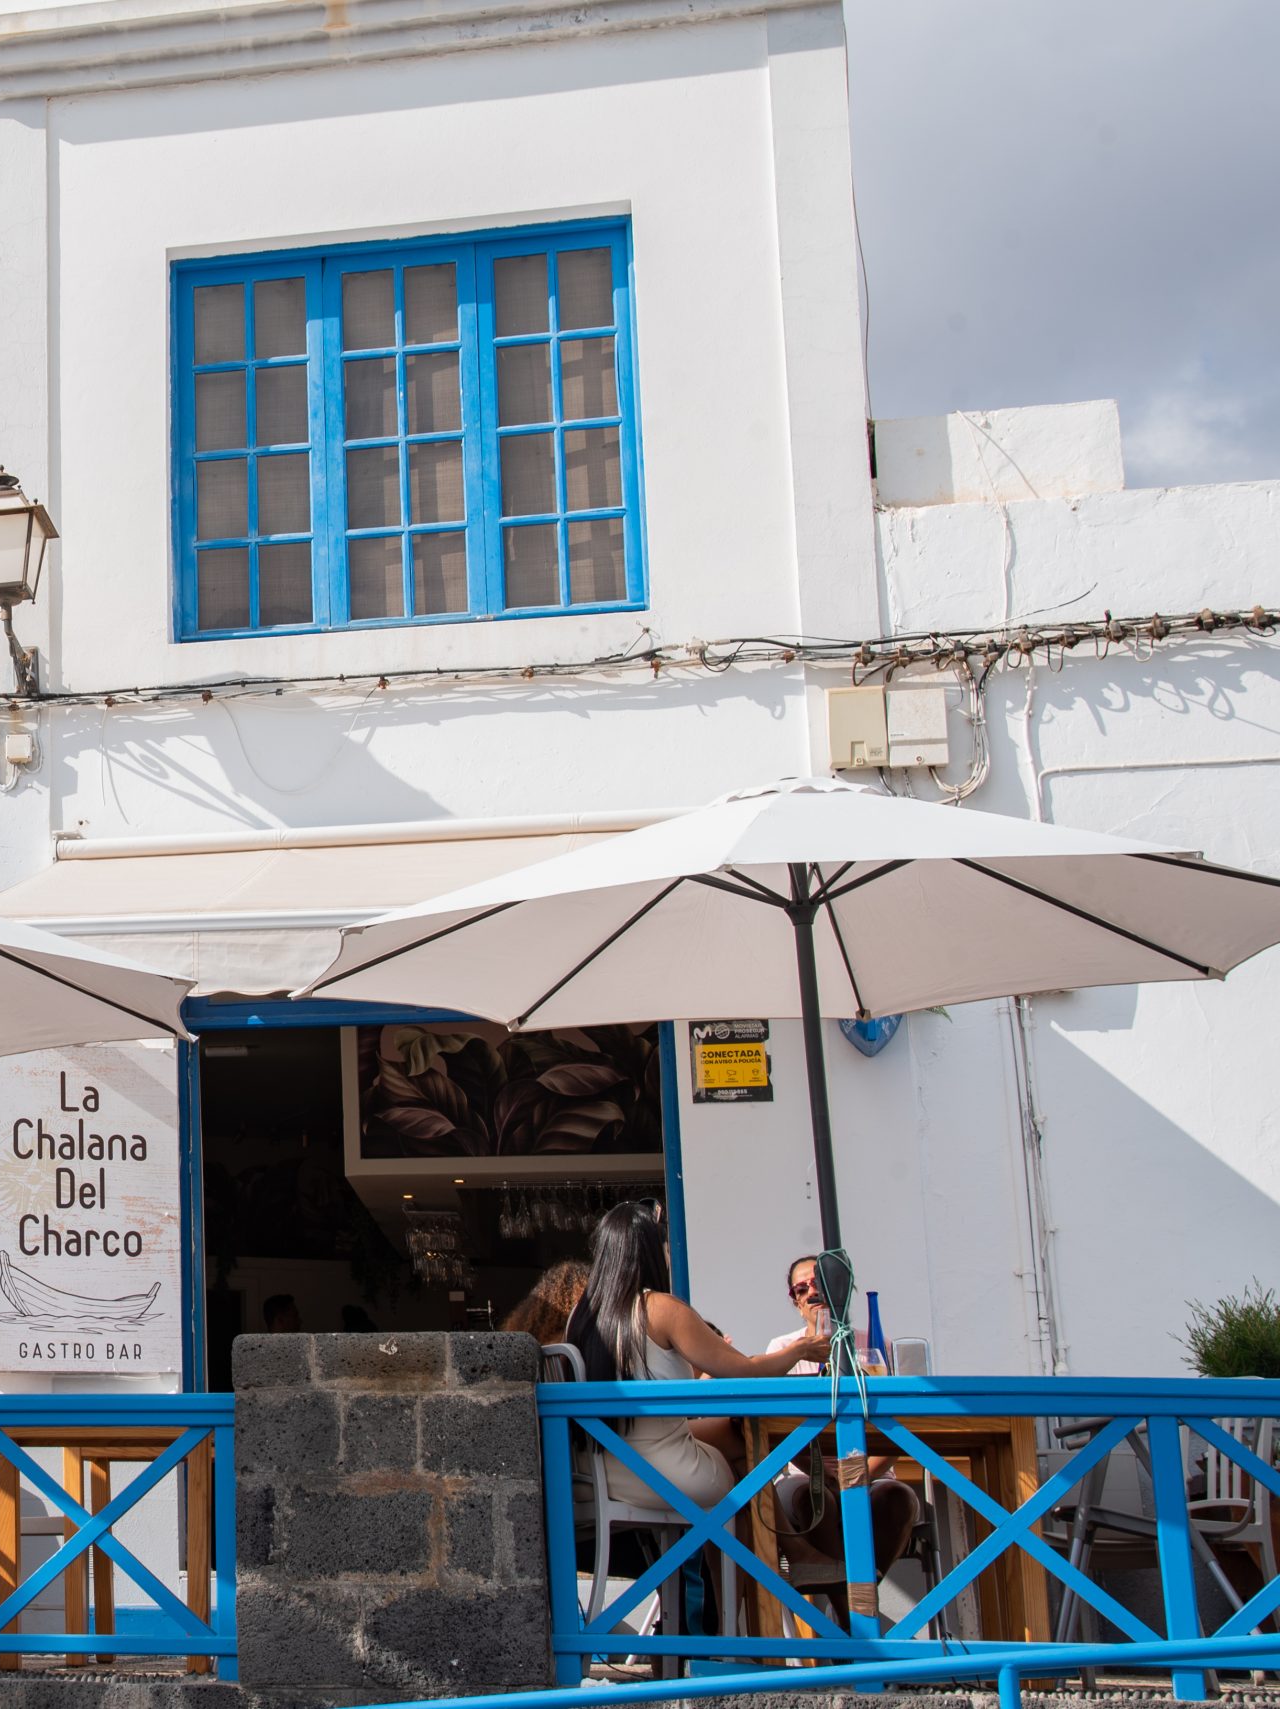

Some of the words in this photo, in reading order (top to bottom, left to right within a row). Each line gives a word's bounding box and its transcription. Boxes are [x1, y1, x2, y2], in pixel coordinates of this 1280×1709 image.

[701, 1050, 761, 1059] CONECTADA
[60, 1071, 99, 1112] La
[13, 1118, 147, 1161] Chalana
[56, 1167, 105, 1209] Del
[19, 1214, 143, 1257] Charco
[19, 1342, 95, 1359] GASTRO
[106, 1343, 142, 1360] BAR
